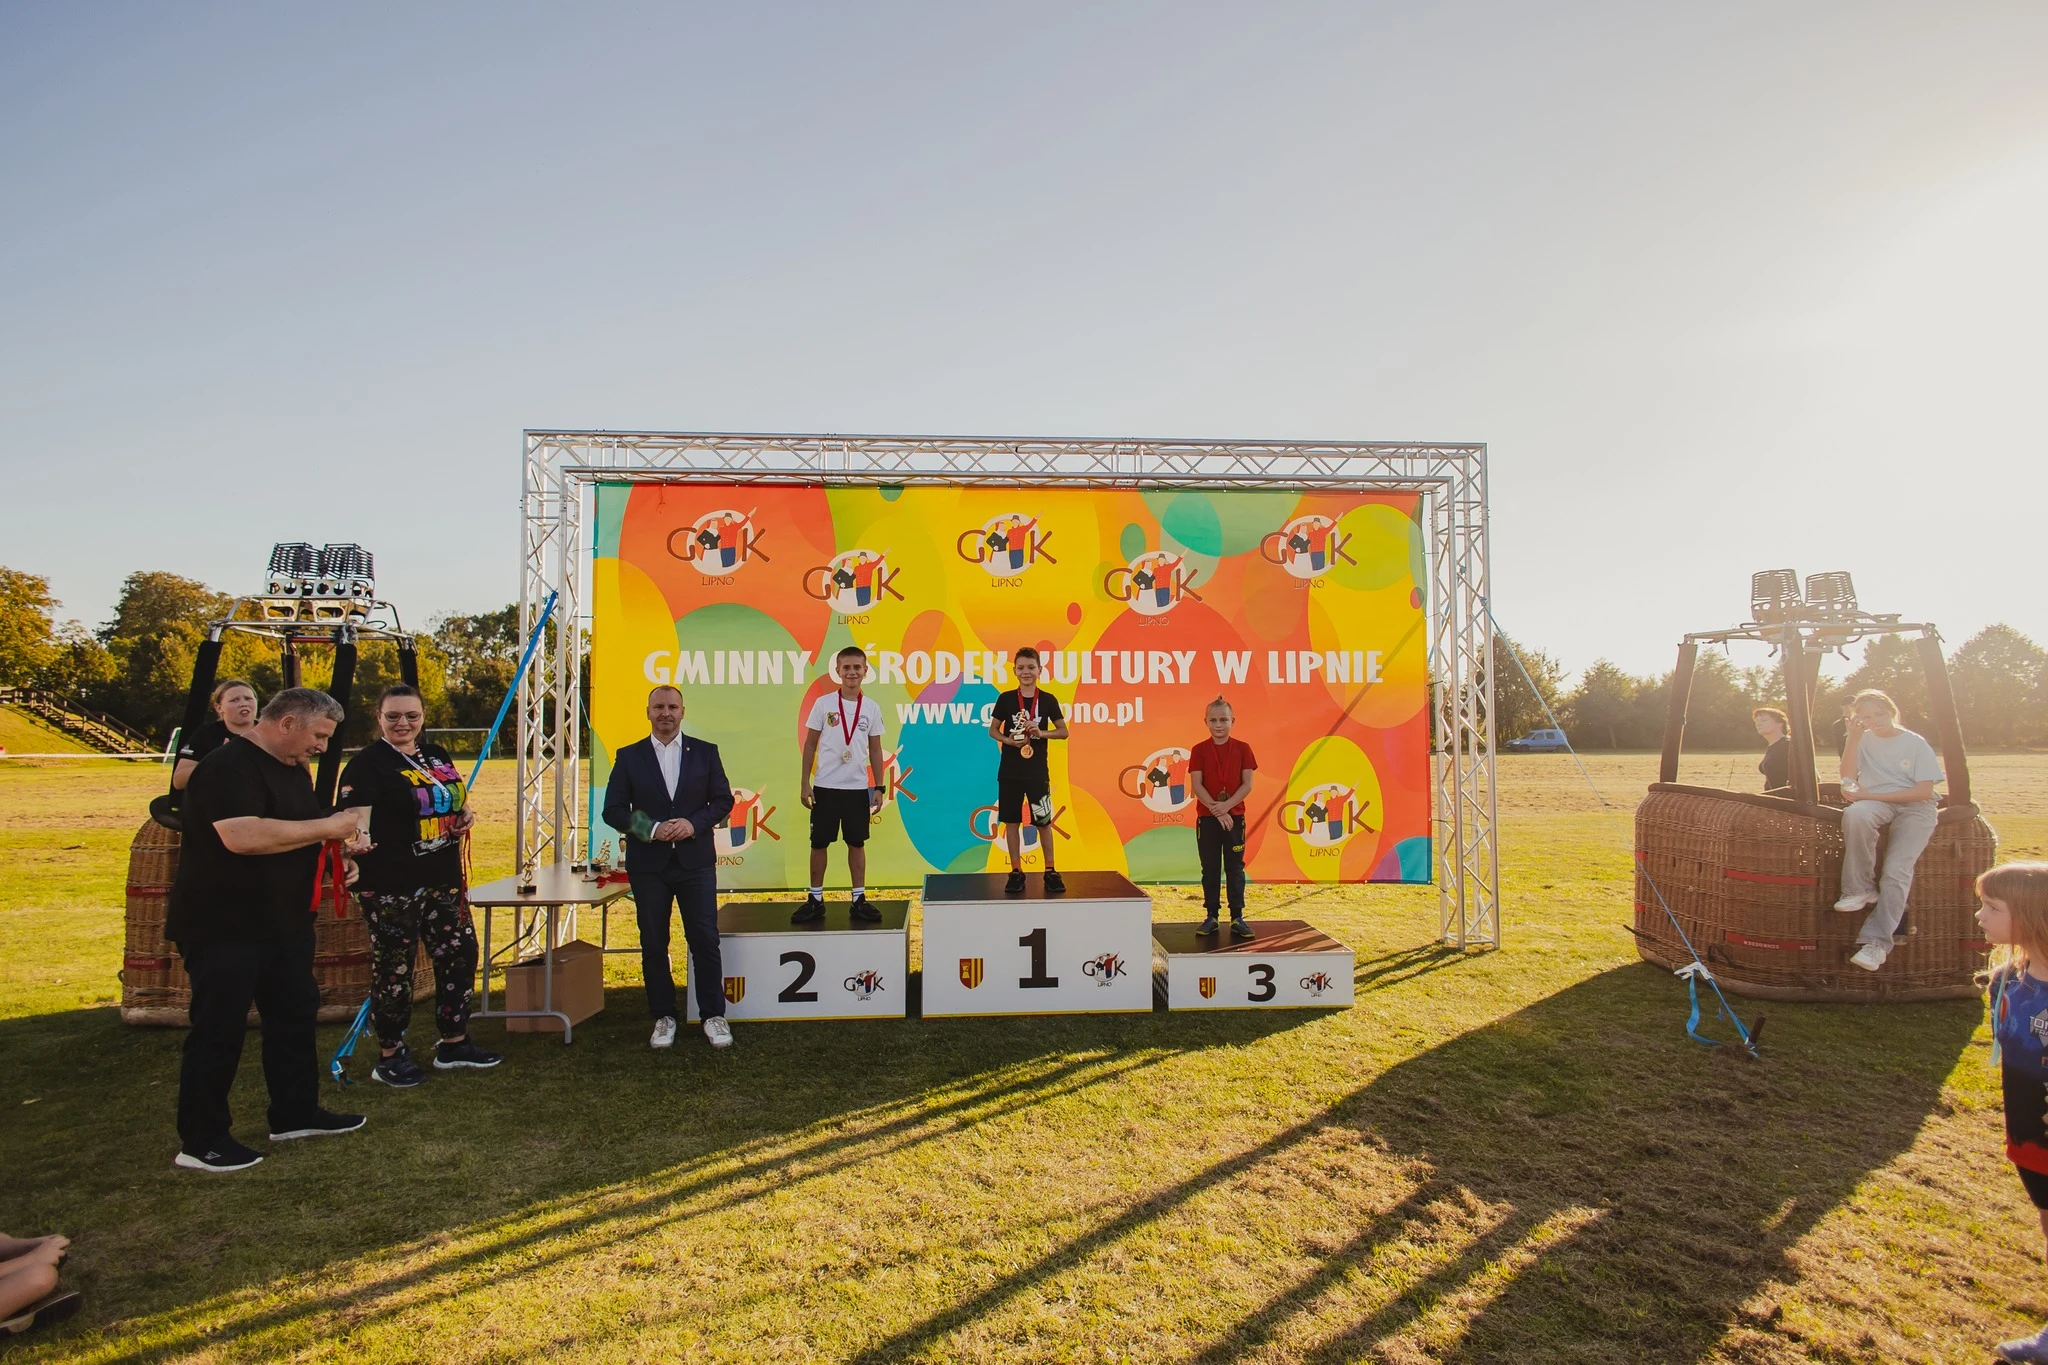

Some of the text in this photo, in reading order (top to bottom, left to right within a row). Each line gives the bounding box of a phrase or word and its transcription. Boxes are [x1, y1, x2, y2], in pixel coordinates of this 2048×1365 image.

[701, 576, 735, 587] LIPNO
[991, 577, 1023, 588] LIPNO
[1293, 578, 1325, 590] LIPNO
[837, 615, 870, 625] LIPNO
[1138, 616, 1170, 627] LIPNO
[643, 650, 812, 684] GMINNY
[1212, 650, 1253, 684] W
[1268, 650, 1383, 684] LIPNIE
[1153, 814, 1184, 825] LIPNO
[1309, 847, 1340, 858] LIPNO
[716, 856, 745, 866] IPNO
[1018, 928, 1059, 989] 1
[778, 951, 818, 1003] 2
[1247, 964, 1277, 1001] 3
